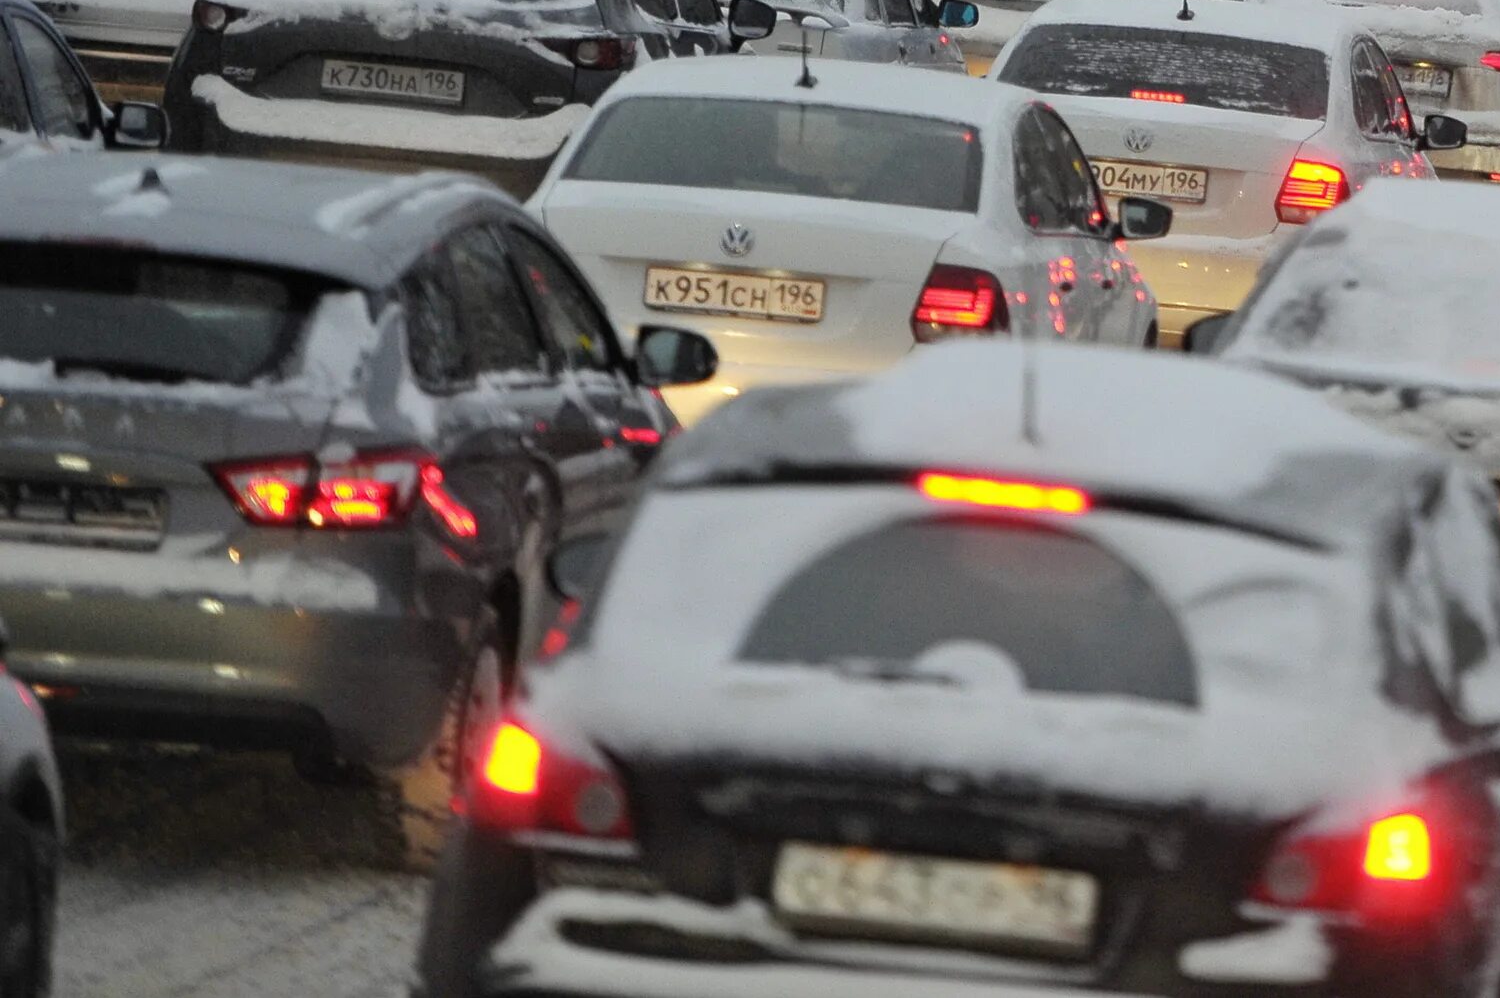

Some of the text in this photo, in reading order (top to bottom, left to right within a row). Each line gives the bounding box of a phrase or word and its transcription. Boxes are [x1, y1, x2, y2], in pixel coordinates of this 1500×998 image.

[329, 65, 457, 92] К730НА 196
[1166, 171, 1199, 190] 196
[655, 275, 817, 308] К951СН 196
